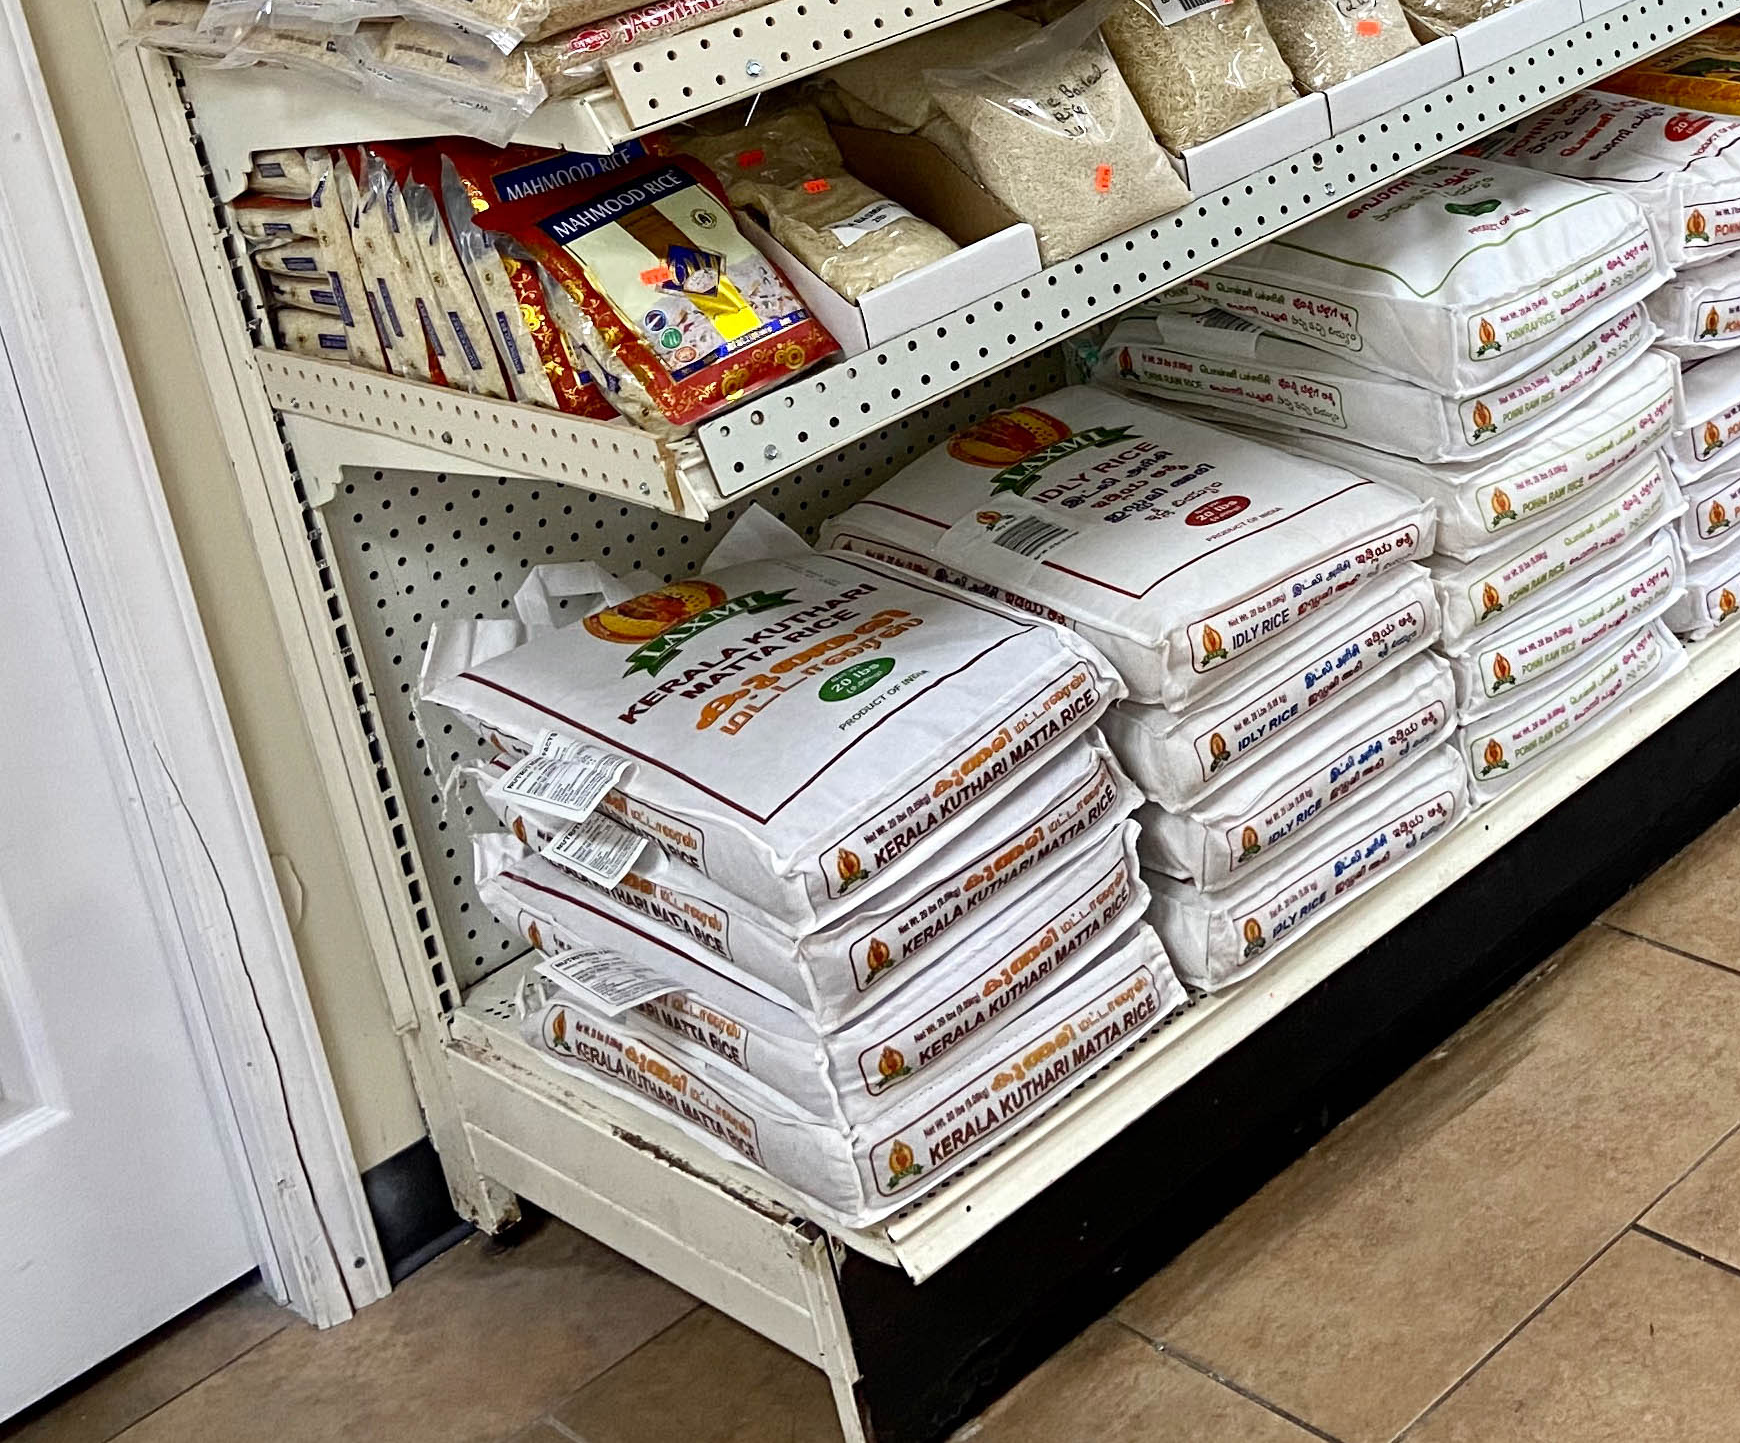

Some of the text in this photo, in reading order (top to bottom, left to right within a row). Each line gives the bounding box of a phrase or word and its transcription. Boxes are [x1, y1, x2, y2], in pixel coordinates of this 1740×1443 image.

[505, 146, 632, 202] MAHMOOD RICE
[552, 171, 684, 240] MAHMOOD RICE
[1004, 429, 1100, 481] LAXMI
[1031, 440, 1161, 504] IDLY RICE
[617, 582, 879, 726] KERALA KUTHARI
[640, 594, 757, 659] LAXMI
[679, 608, 861, 700] MATTA RICE
[1231, 626, 1260, 652] IDLY
[1261, 607, 1291, 637] RICE
[830, 662, 881, 693] 20 lbs
[838, 668, 929, 731] PRODUCT OF INDIA
[1237, 702, 1300, 753] IDLY RICE
[873, 812, 939, 870] KERALA
[938, 756, 1009, 813] KUTHARI
[1009, 719, 1061, 766] MATTA
[1061, 689, 1097, 727] RICE
[1267, 797, 1323, 847] IDLY RICE
[901, 905, 963, 958] KERALA
[966, 857, 1035, 913] KUTHARI
[1035, 820, 1086, 862] MATTA
[1086, 785, 1116, 822] RICE
[1271, 889, 1328, 939] IDLY RICE
[917, 1009, 986, 1066] KERALA
[988, 959, 1052, 1016] KUTHARI
[1055, 919, 1102, 965] MATTA
[1102, 890, 1131, 924] RICE
[575, 1038, 625, 1079] KERALA
[928, 1106, 1002, 1166] KERALA
[999, 1054, 1071, 1114] KUTHARI
[1071, 1022, 1123, 1068] MATTA
[1122, 993, 1158, 1032] RICE
